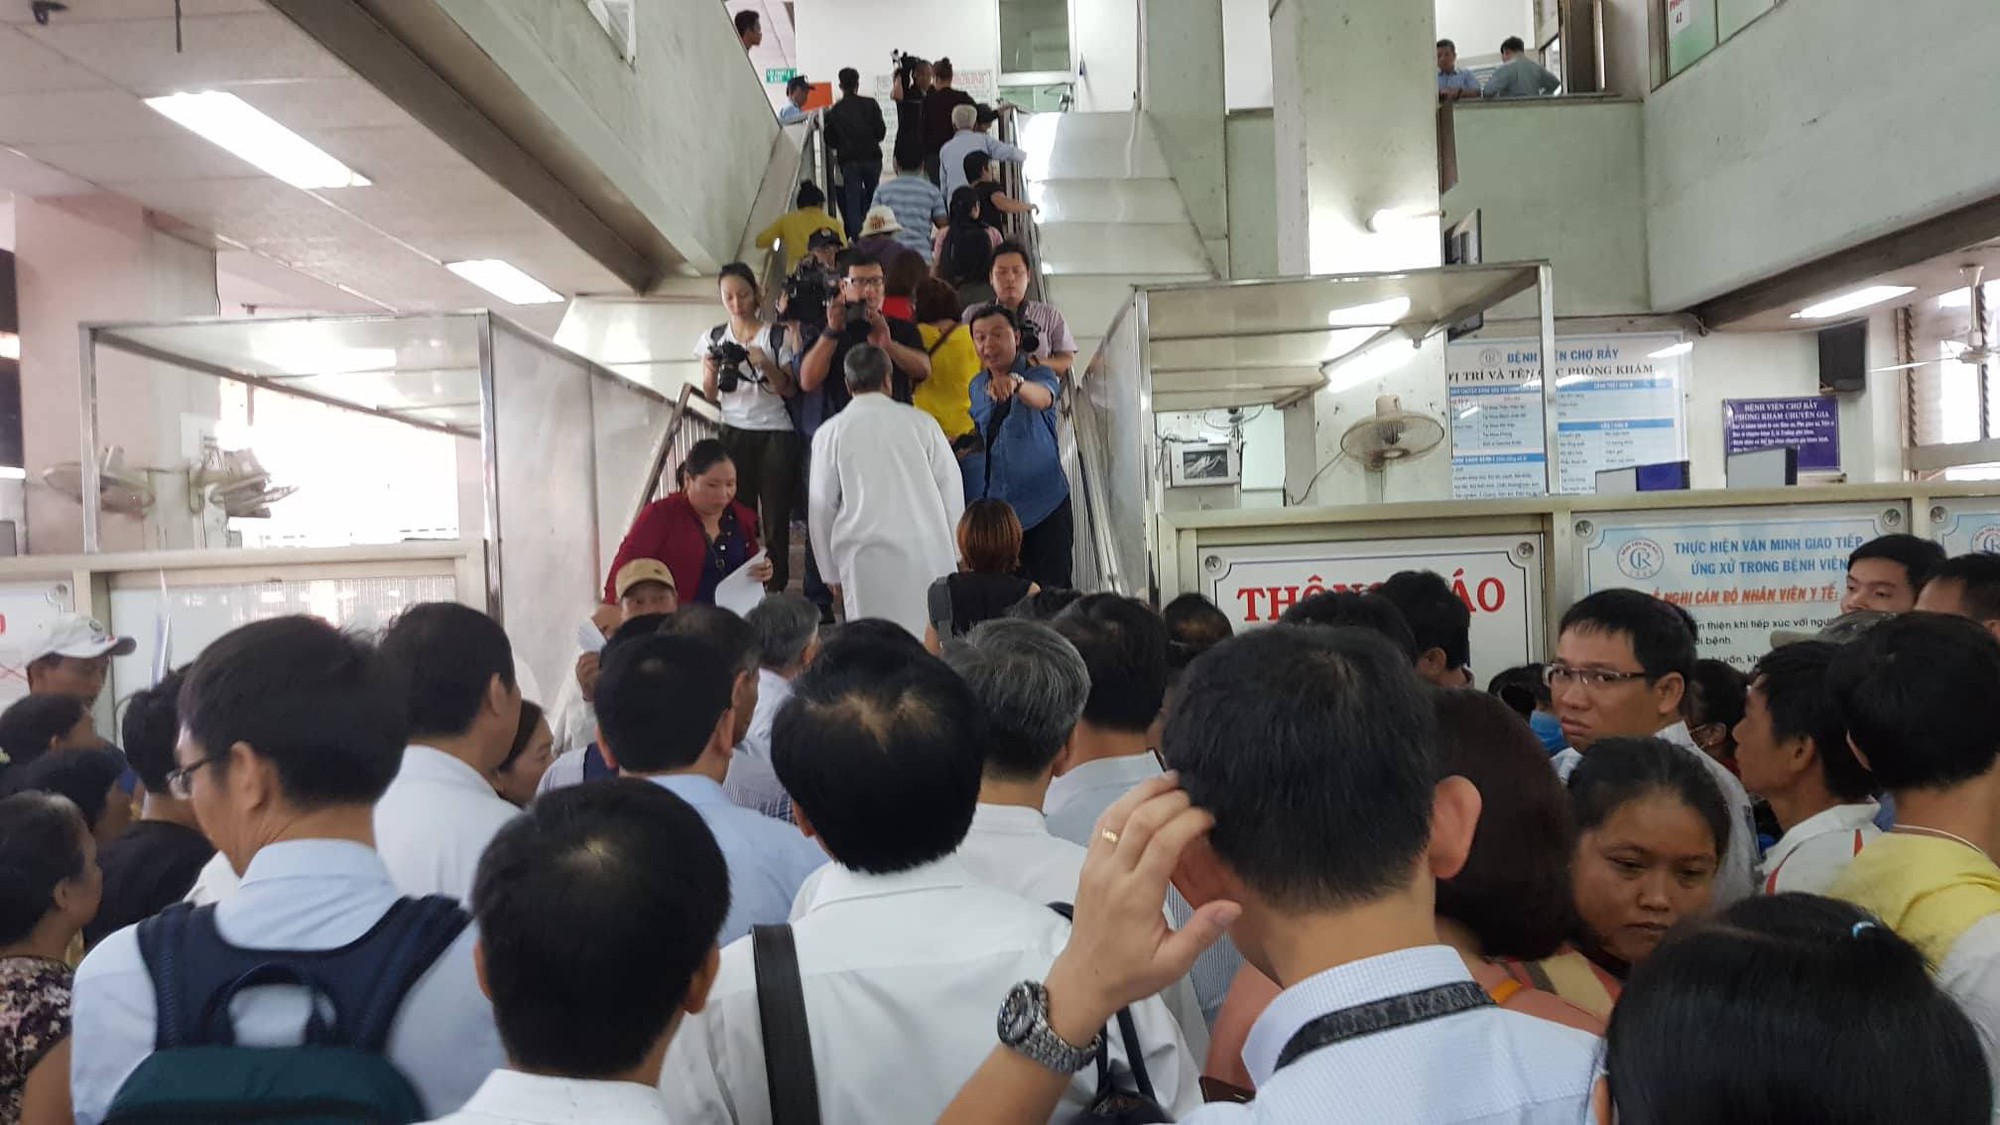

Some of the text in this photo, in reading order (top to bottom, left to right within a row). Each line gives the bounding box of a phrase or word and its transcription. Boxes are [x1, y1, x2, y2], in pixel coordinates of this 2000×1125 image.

[1674, 541, 1706, 556] THỰC
[1710, 538, 1739, 555] HIỆN
[1743, 537, 1766, 553] VĂN
[1771, 539, 1800, 551] MINH
[1805, 537, 1832, 550] GIAO
[1837, 533, 1863, 549] TIẾP
[1691, 556, 1849, 575] ỨNG XỬ TRONG BỆNH VIỆN
[1696, 587, 1719, 604] CÁN
[1742, 585, 1776, 602] NHÂN
[1780, 583, 1807, 602] VIÊN
[1811, 587, 1817, 599] Y
[1707, 619, 1731, 631] thiện
[1734, 619, 1748, 629] khi
[1751, 619, 1770, 631] tiếp
[1773, 618, 1790, 628] xúc
